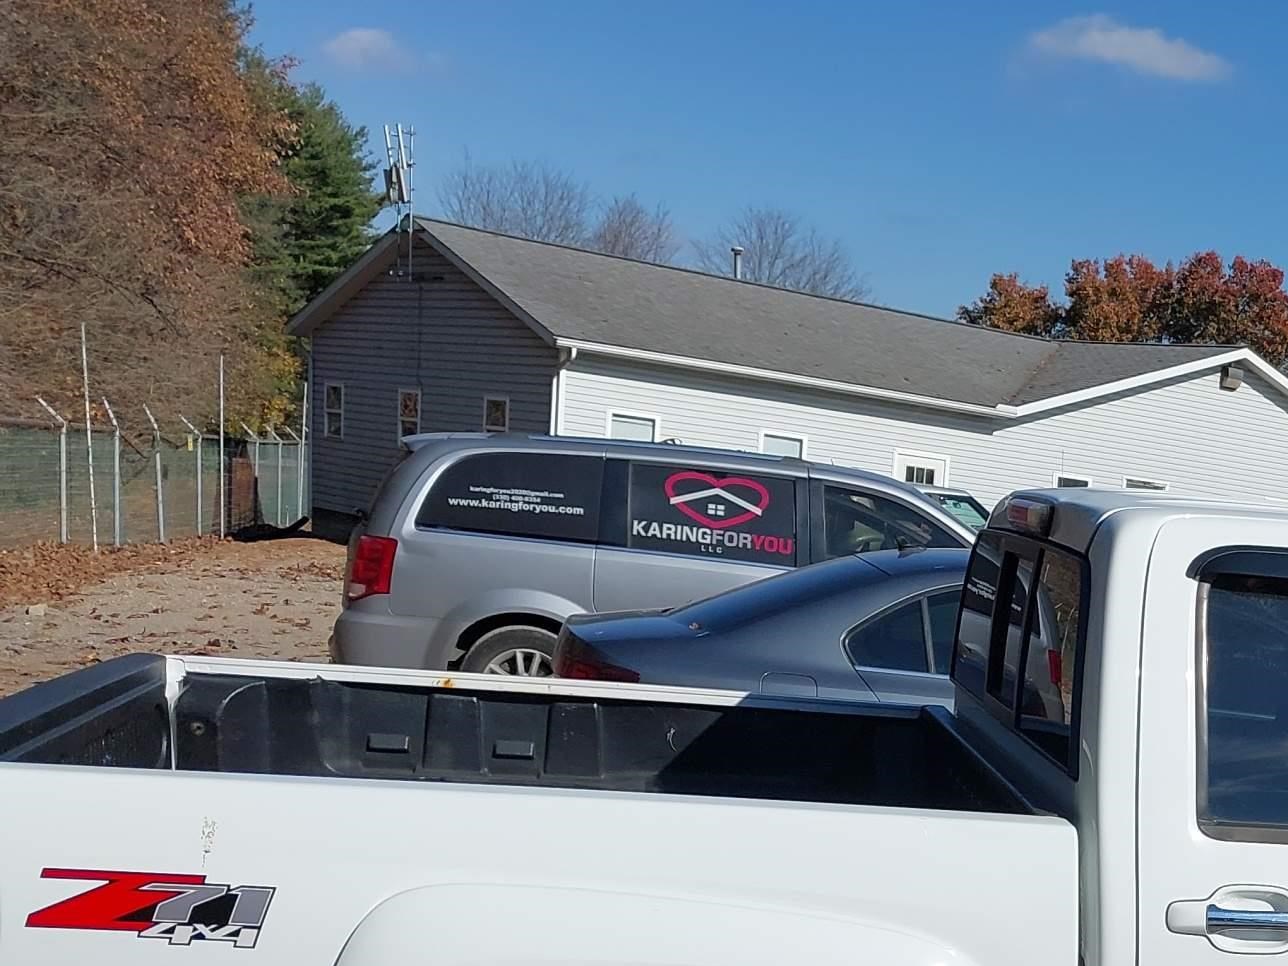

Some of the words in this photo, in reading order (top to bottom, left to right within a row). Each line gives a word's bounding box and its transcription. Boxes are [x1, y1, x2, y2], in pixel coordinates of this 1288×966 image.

[448, 497, 584, 516] www.karingforyou.com
[632, 520, 793, 555] KARINGFORYOU
[24, 867, 277, 935] Z71
